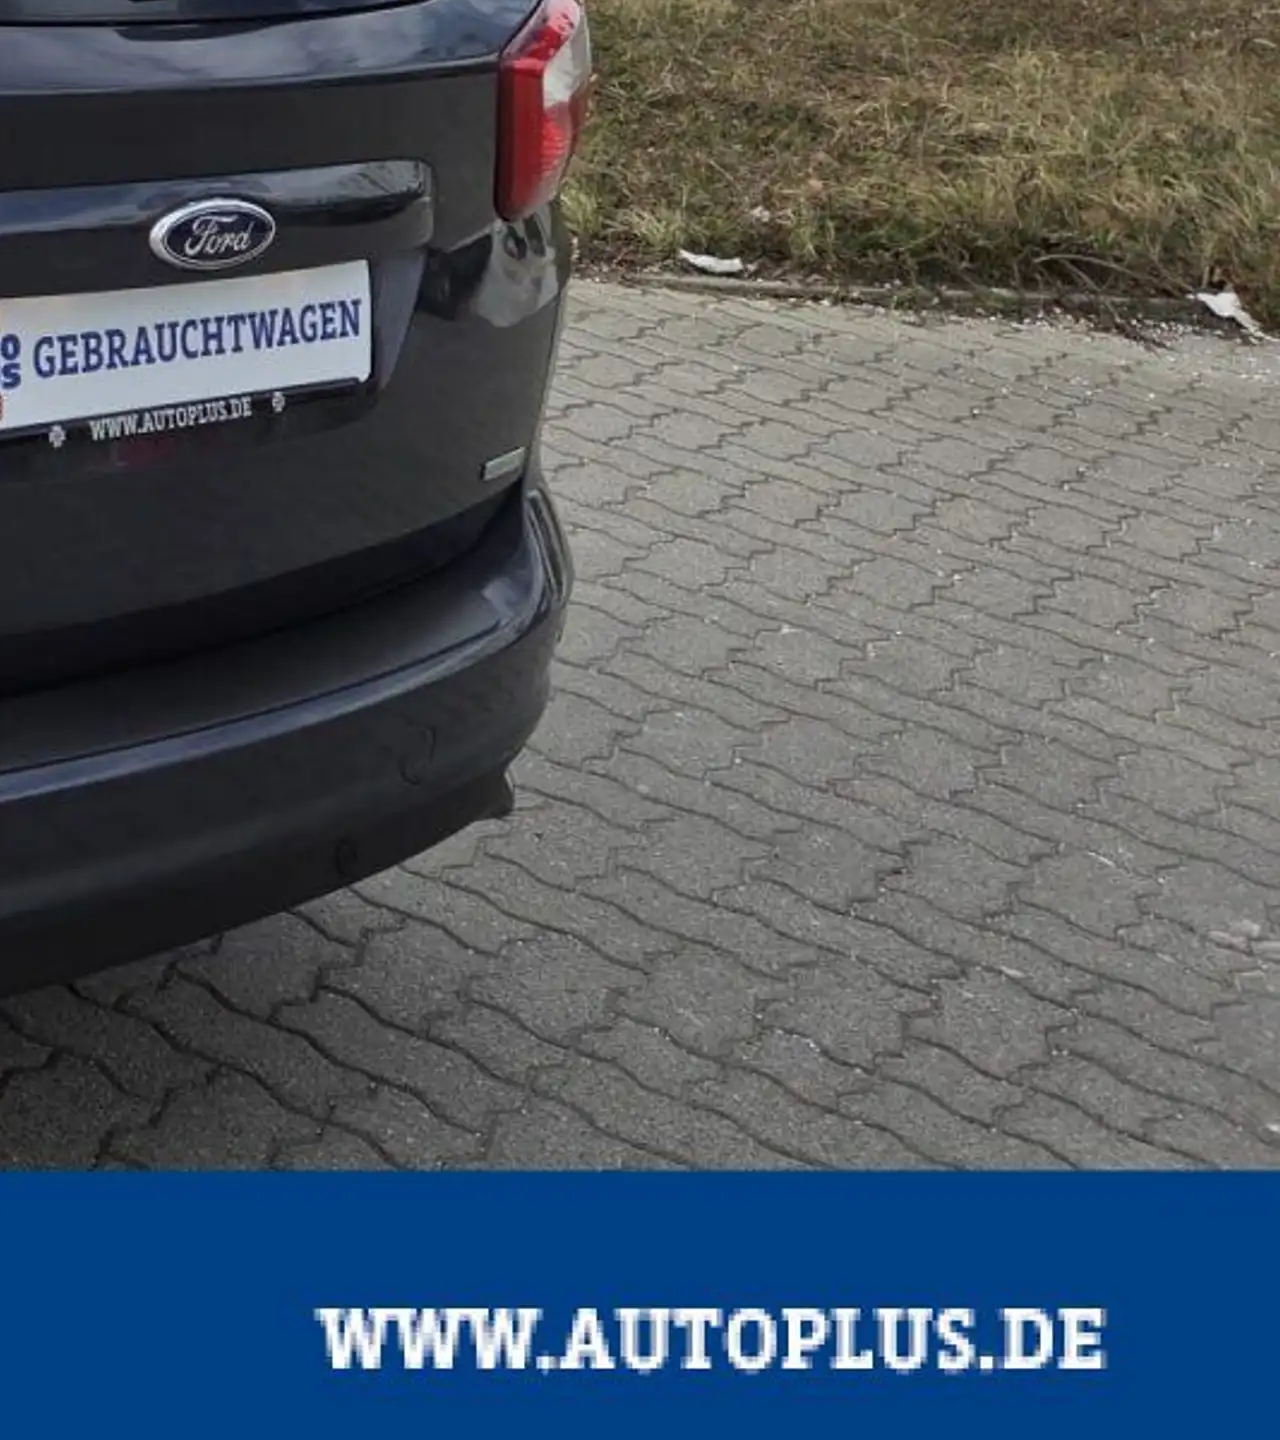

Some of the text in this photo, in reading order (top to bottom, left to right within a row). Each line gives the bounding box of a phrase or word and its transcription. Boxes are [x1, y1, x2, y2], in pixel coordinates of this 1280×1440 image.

[184, 213, 256, 256] Ford
[33, 298, 362, 379] GEBRAUCHTWAGEN
[89, 396, 253, 441] WWW.AUTOPLUS.DE
